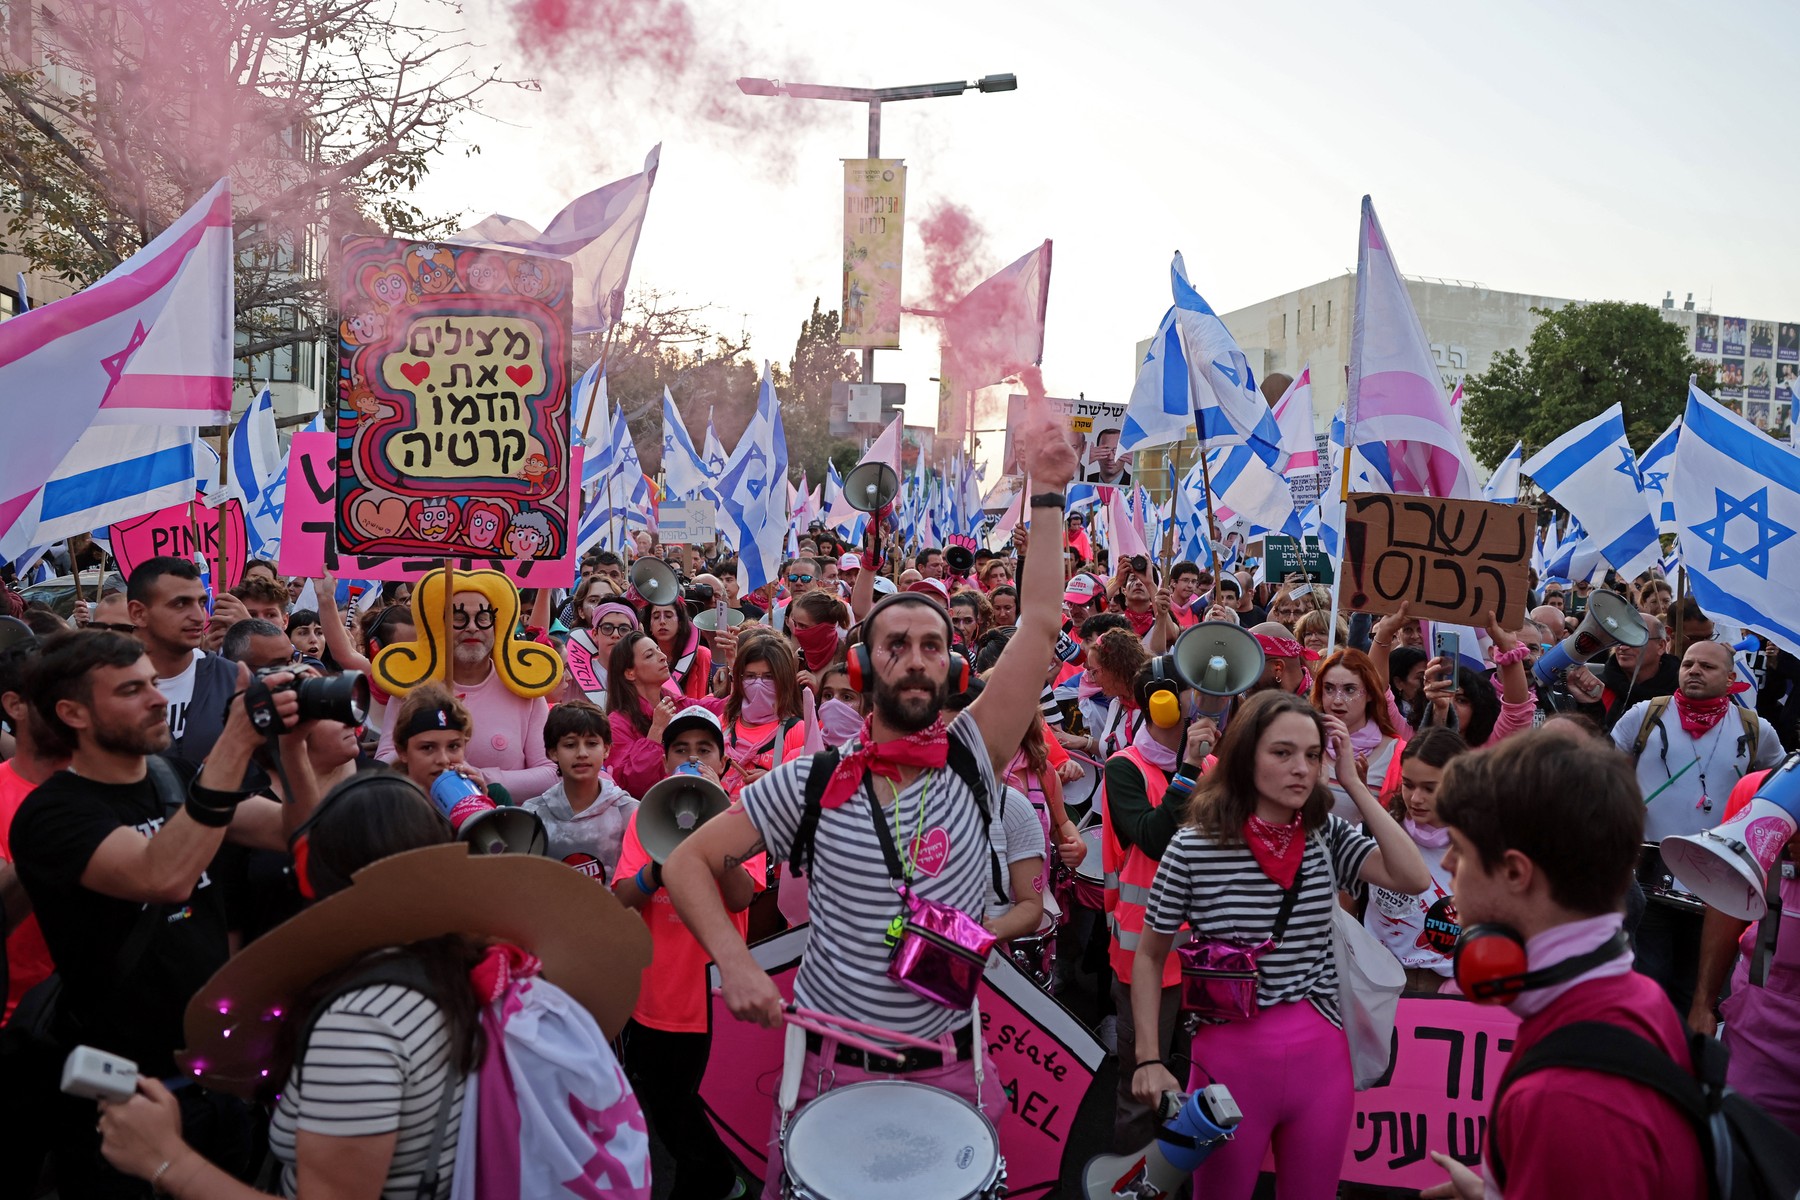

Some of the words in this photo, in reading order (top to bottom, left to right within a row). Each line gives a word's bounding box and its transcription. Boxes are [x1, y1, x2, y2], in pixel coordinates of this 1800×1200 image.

[409, 318, 531, 361] מצילים
[441, 363, 499, 389] את
[402, 429, 527, 474] קרטיה
[151, 521, 220, 557] PINK
[1354, 494, 1527, 564] נשבר
[570, 643, 597, 688] WATCH
[998, 1024, 1068, 1082] state
[1000, 1077, 1061, 1143] AEL
[1353, 1111, 1427, 1170] עתי
